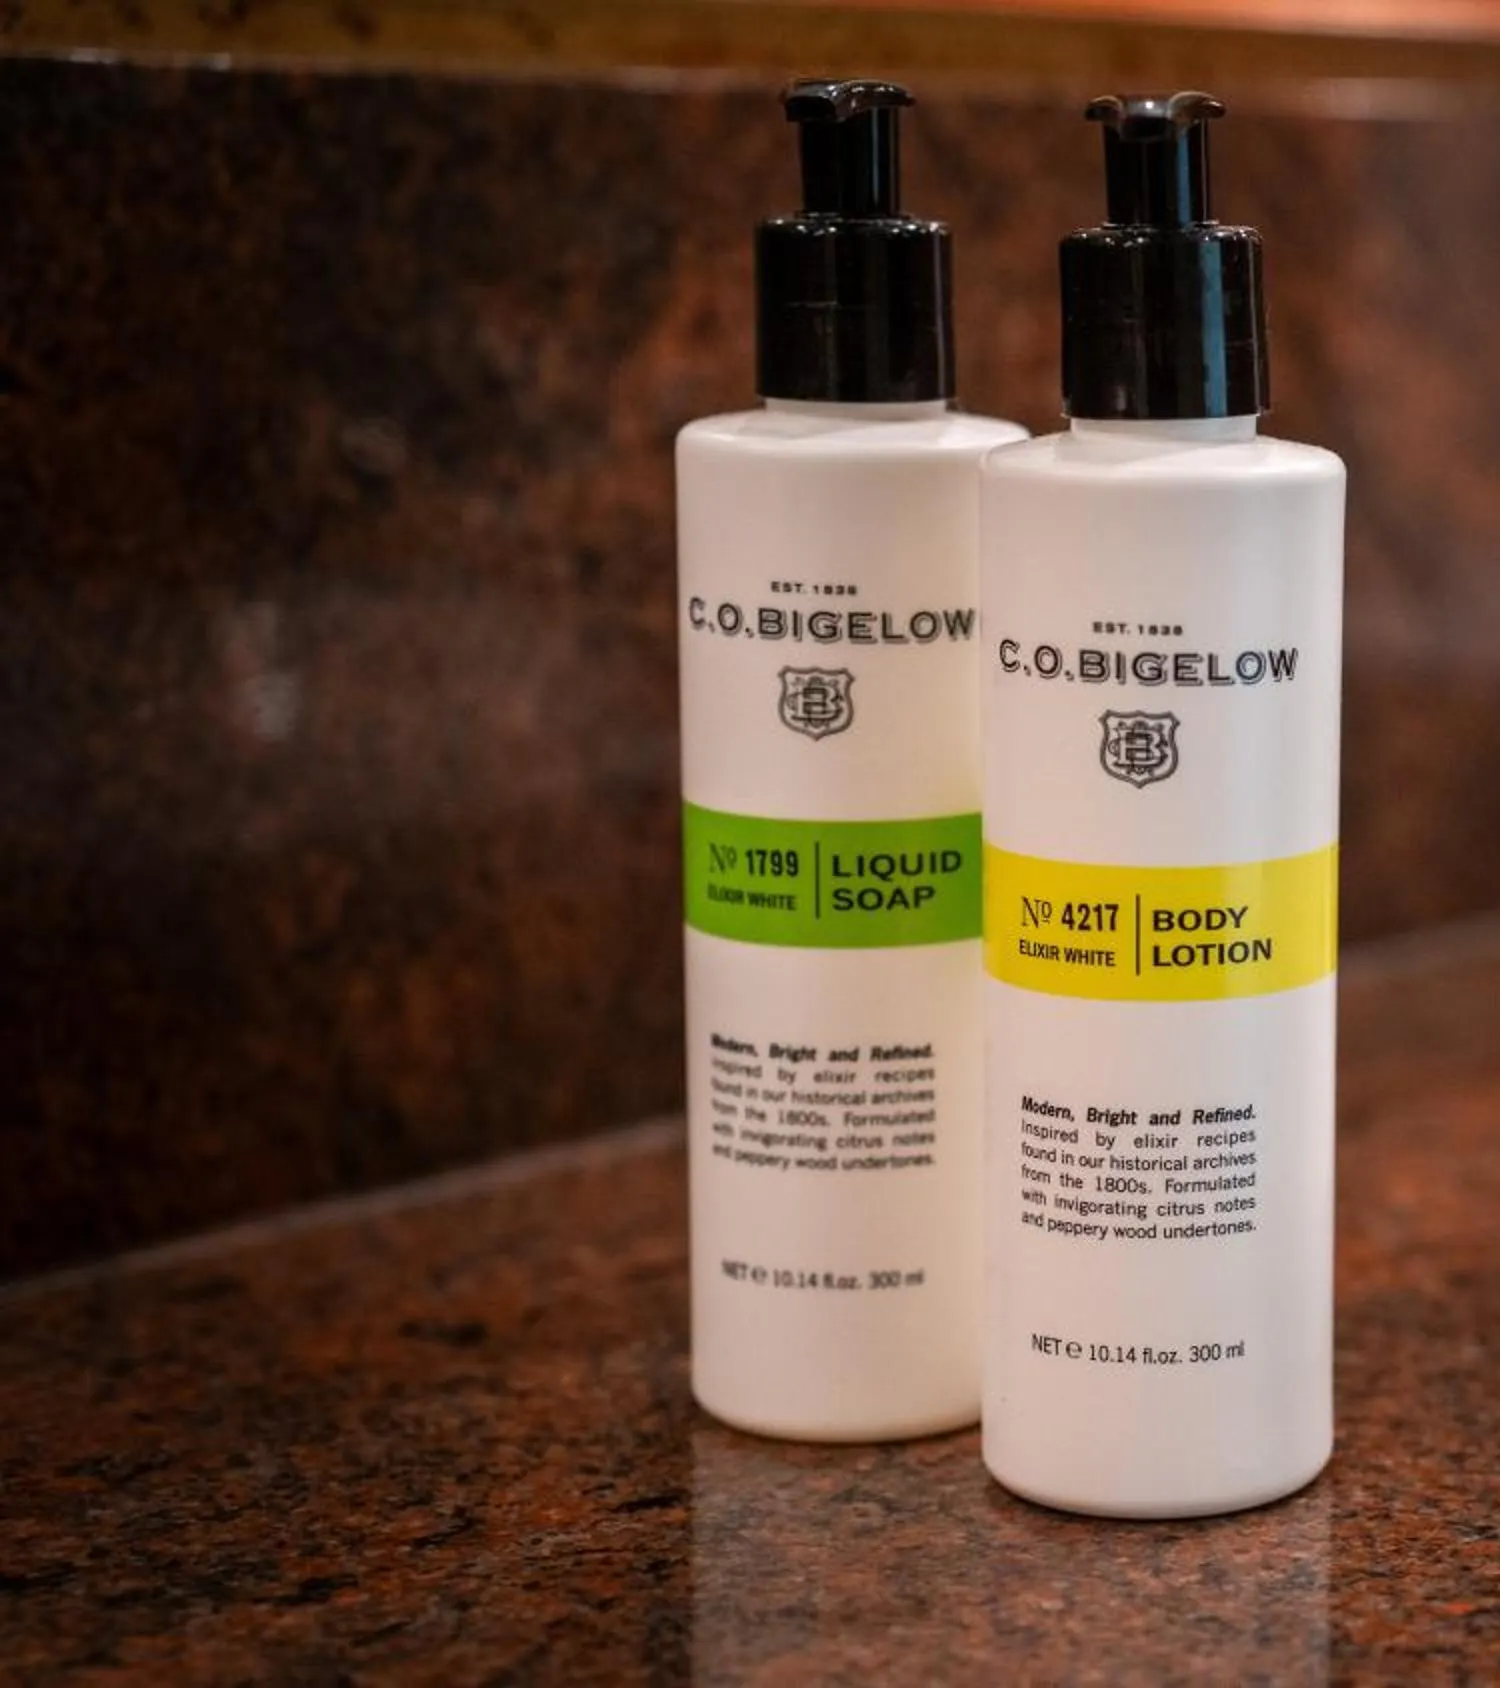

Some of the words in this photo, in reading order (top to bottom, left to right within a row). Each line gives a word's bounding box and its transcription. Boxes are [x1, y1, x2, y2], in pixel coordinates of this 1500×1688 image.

[1093, 621, 1130, 635] EST.
[745, 848, 799, 878] 1799
[831, 850, 962, 881] LIQUID
[746, 891, 797, 912] WHITE
[832, 885, 936, 911] SOAP
[1061, 902, 1119, 931] 4217
[1152, 906, 1249, 931] BODY
[1019, 938, 1060, 961] ELIXIR
[1064, 947, 1116, 967] WHITE
[1153, 938, 1272, 967] LOTION
[769, 1042, 817, 1063] Bright
[828, 1046, 859, 1062] and
[778, 1067, 796, 1084] by
[814, 1070, 856, 1083] elixir
[874, 1067, 934, 1083] recipes
[791, 1089, 866, 1105] historical
[1021, 1096, 1075, 1122] Modern,
[1087, 1106, 1138, 1127] Bright
[1149, 1110, 1181, 1126] and
[1192, 1104, 1256, 1125] Refined.
[844, 1108, 935, 1127] Formulated
[836, 1132, 883, 1148] citrus
[1021, 1119, 1078, 1143] Inspired
[1096, 1131, 1116, 1150] by
[1133, 1134, 1179, 1148] elixir
[1197, 1129, 1256, 1148] recipes
[796, 1155, 837, 1170] wood
[1021, 1142, 1057, 1163] found
[1061, 1150, 1075, 1165] in
[1079, 1155, 1104, 1169] our
[1110, 1154, 1187, 1171] historical
[1193, 1151, 1256, 1170] archives
[1021, 1164, 1051, 1184] from
[1059, 1173, 1083, 1189] the
[1096, 1176, 1152, 1194] 1800s.
[1165, 1172, 1256, 1194] Formulated
[1021, 1189, 1047, 1205] with
[1054, 1194, 1147, 1220] invigorating
[1156, 1198, 1205, 1216] citrus
[1214, 1196, 1256, 1214] notes
[1022, 1211, 1044, 1227] and
[1047, 1215, 1109, 1240] peppery
[1114, 1224, 1157, 1239] wood
[1163, 1219, 1257, 1239] undertones.
[1032, 1333, 1062, 1356] NET
[1089, 1344, 1137, 1363] 10.14
[1189, 1343, 1221, 1363] 300
[1226, 1339, 1245, 1359] ml
